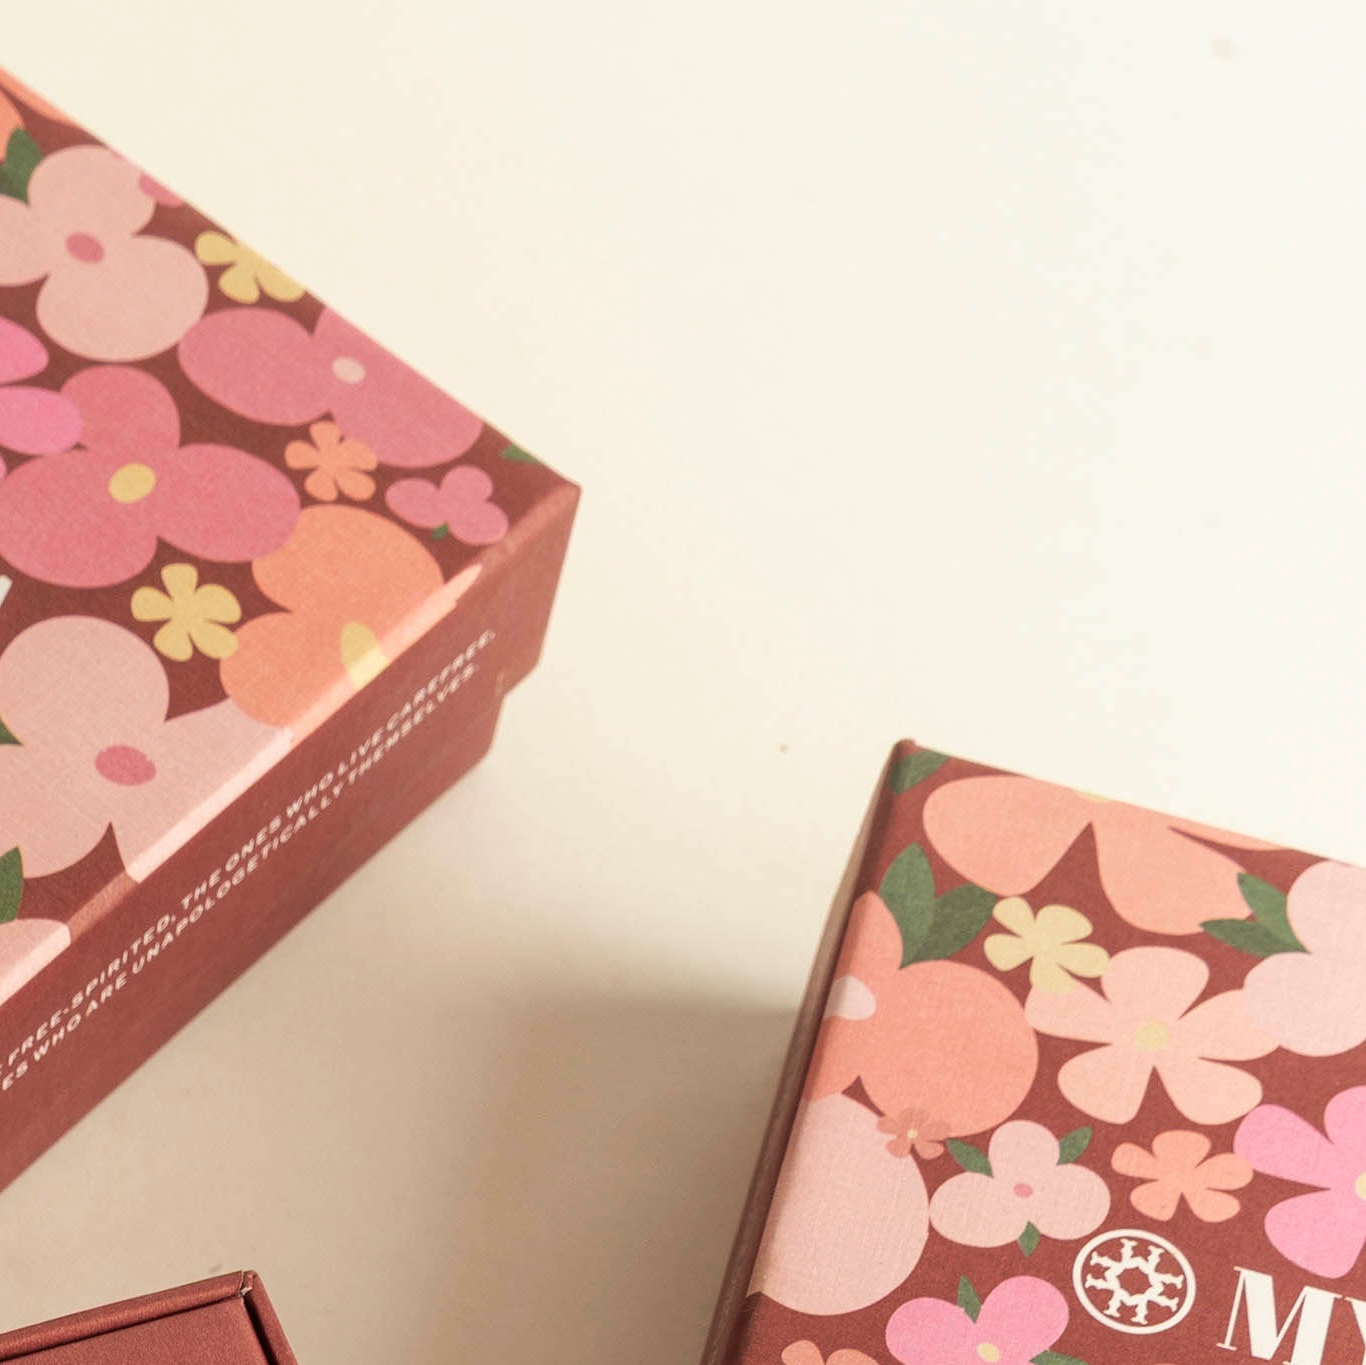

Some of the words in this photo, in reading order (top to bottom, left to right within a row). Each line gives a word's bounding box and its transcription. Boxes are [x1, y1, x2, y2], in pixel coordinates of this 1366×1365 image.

[8, 914, 176, 1066] FREE-SPIRITED,
[181, 868, 222, 910] THE
[225, 815, 282, 872] ONES
[286, 772, 334, 818] WHO
[337, 727, 384, 776] LIVE
[33, 1013, 81, 1062] WHO
[86, 972, 127, 1017] ARE
[132, 781, 344, 975] UNAPOLOGETICALLY
